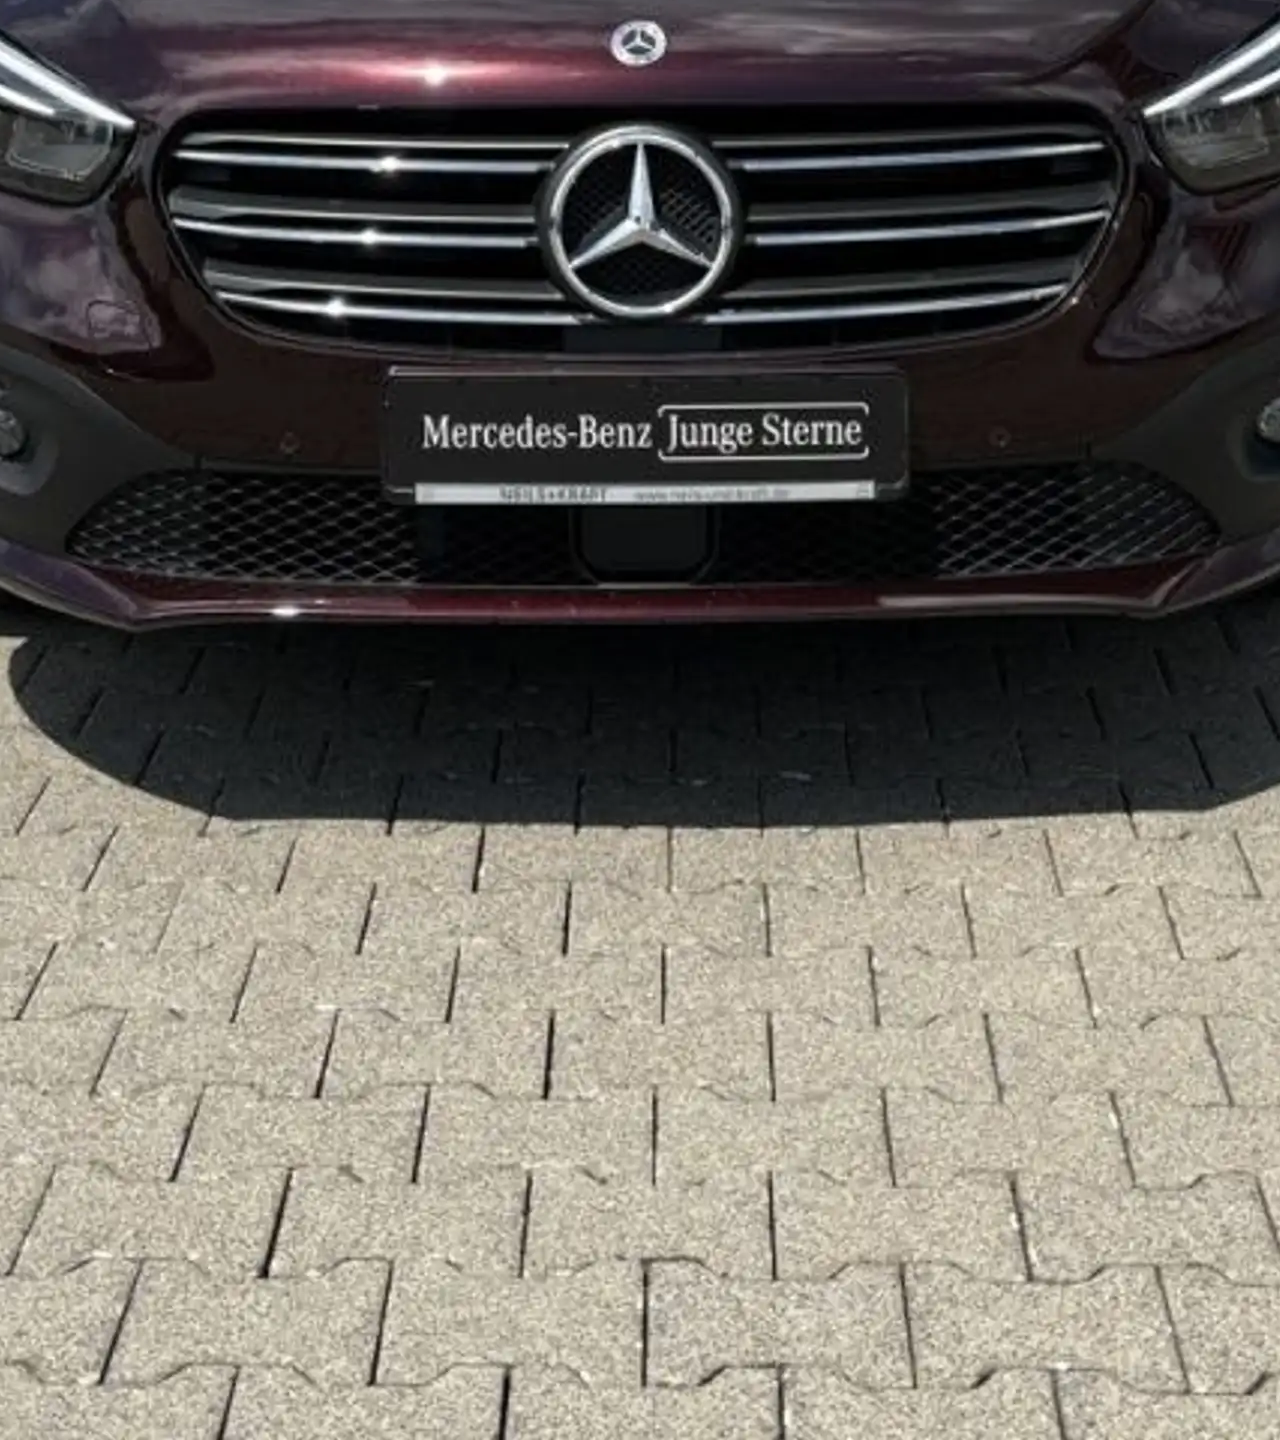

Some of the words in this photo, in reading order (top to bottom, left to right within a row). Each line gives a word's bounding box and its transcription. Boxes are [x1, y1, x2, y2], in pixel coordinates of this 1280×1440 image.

[422, 414, 653, 450] Mercedes-Benz
[668, 413, 754, 454] Junge
[762, 412, 863, 446] Sterne
